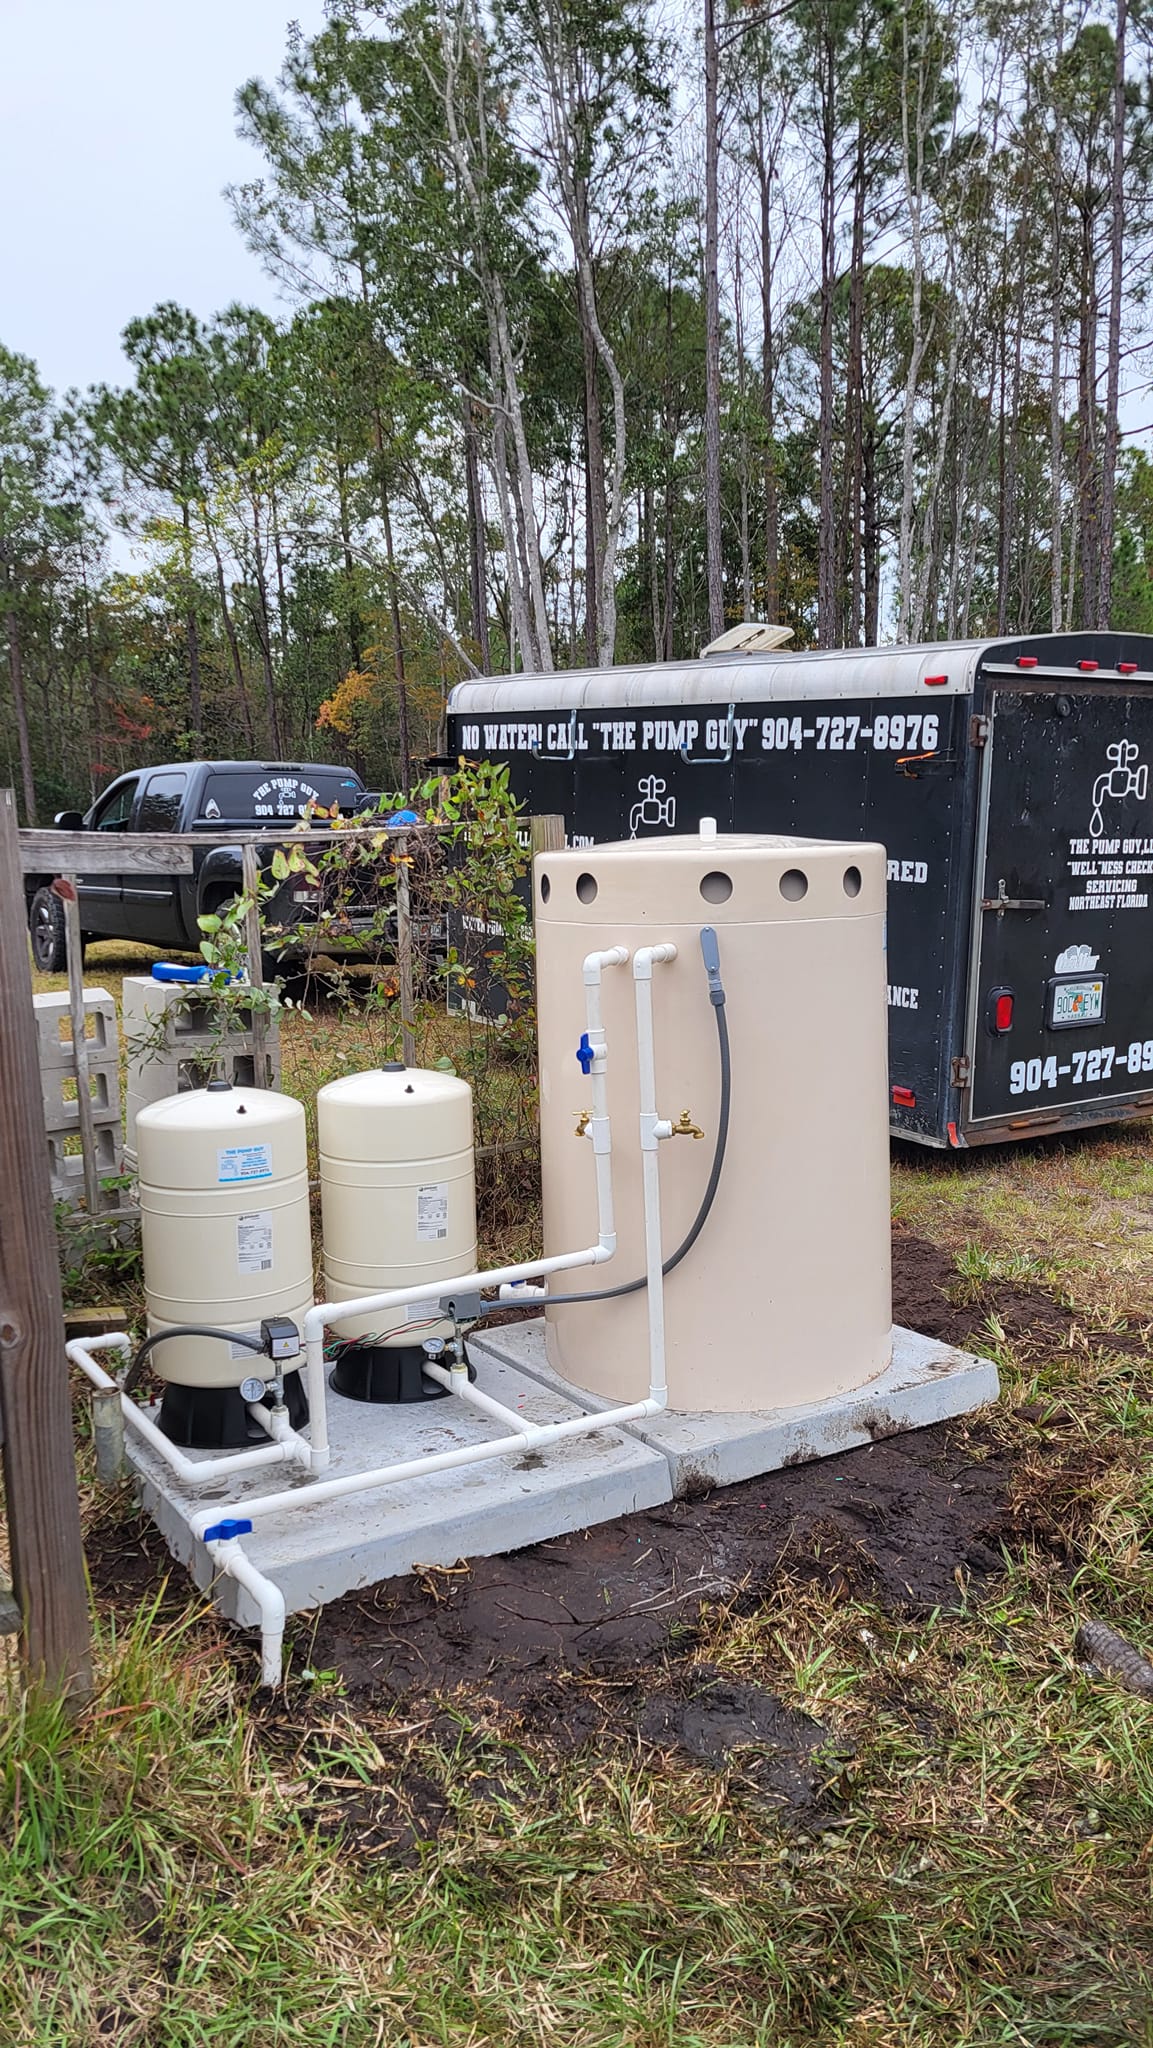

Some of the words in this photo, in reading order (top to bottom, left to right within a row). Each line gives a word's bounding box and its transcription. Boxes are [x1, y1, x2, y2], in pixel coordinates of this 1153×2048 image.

[462, 725, 480, 750] NO
[483, 723, 543, 750] WATER!
[547, 722, 589, 750] CALL
[592, 721, 636, 750] "THE
[642, 719, 699, 750] PUMP
[706, 718, 758, 750] GUY"
[762, 714, 939, 750] 904-727-8976
[253, 782, 271, 800] THE
[270, 778, 298, 790] PUMP
[300, 782, 319, 801] GUY
[255, 805, 274, 816] 904
[277, 805, 294, 816] 727
[1069, 838, 1090, 855] THE
[1091, 838, 1121, 855] PUMP
[886, 859, 929, 884] RED
[1086, 879, 1138, 894] SERVICING
[1068, 895, 1116, 911] NORTHEAST
[1116, 893, 1148, 909] FLORIDA
